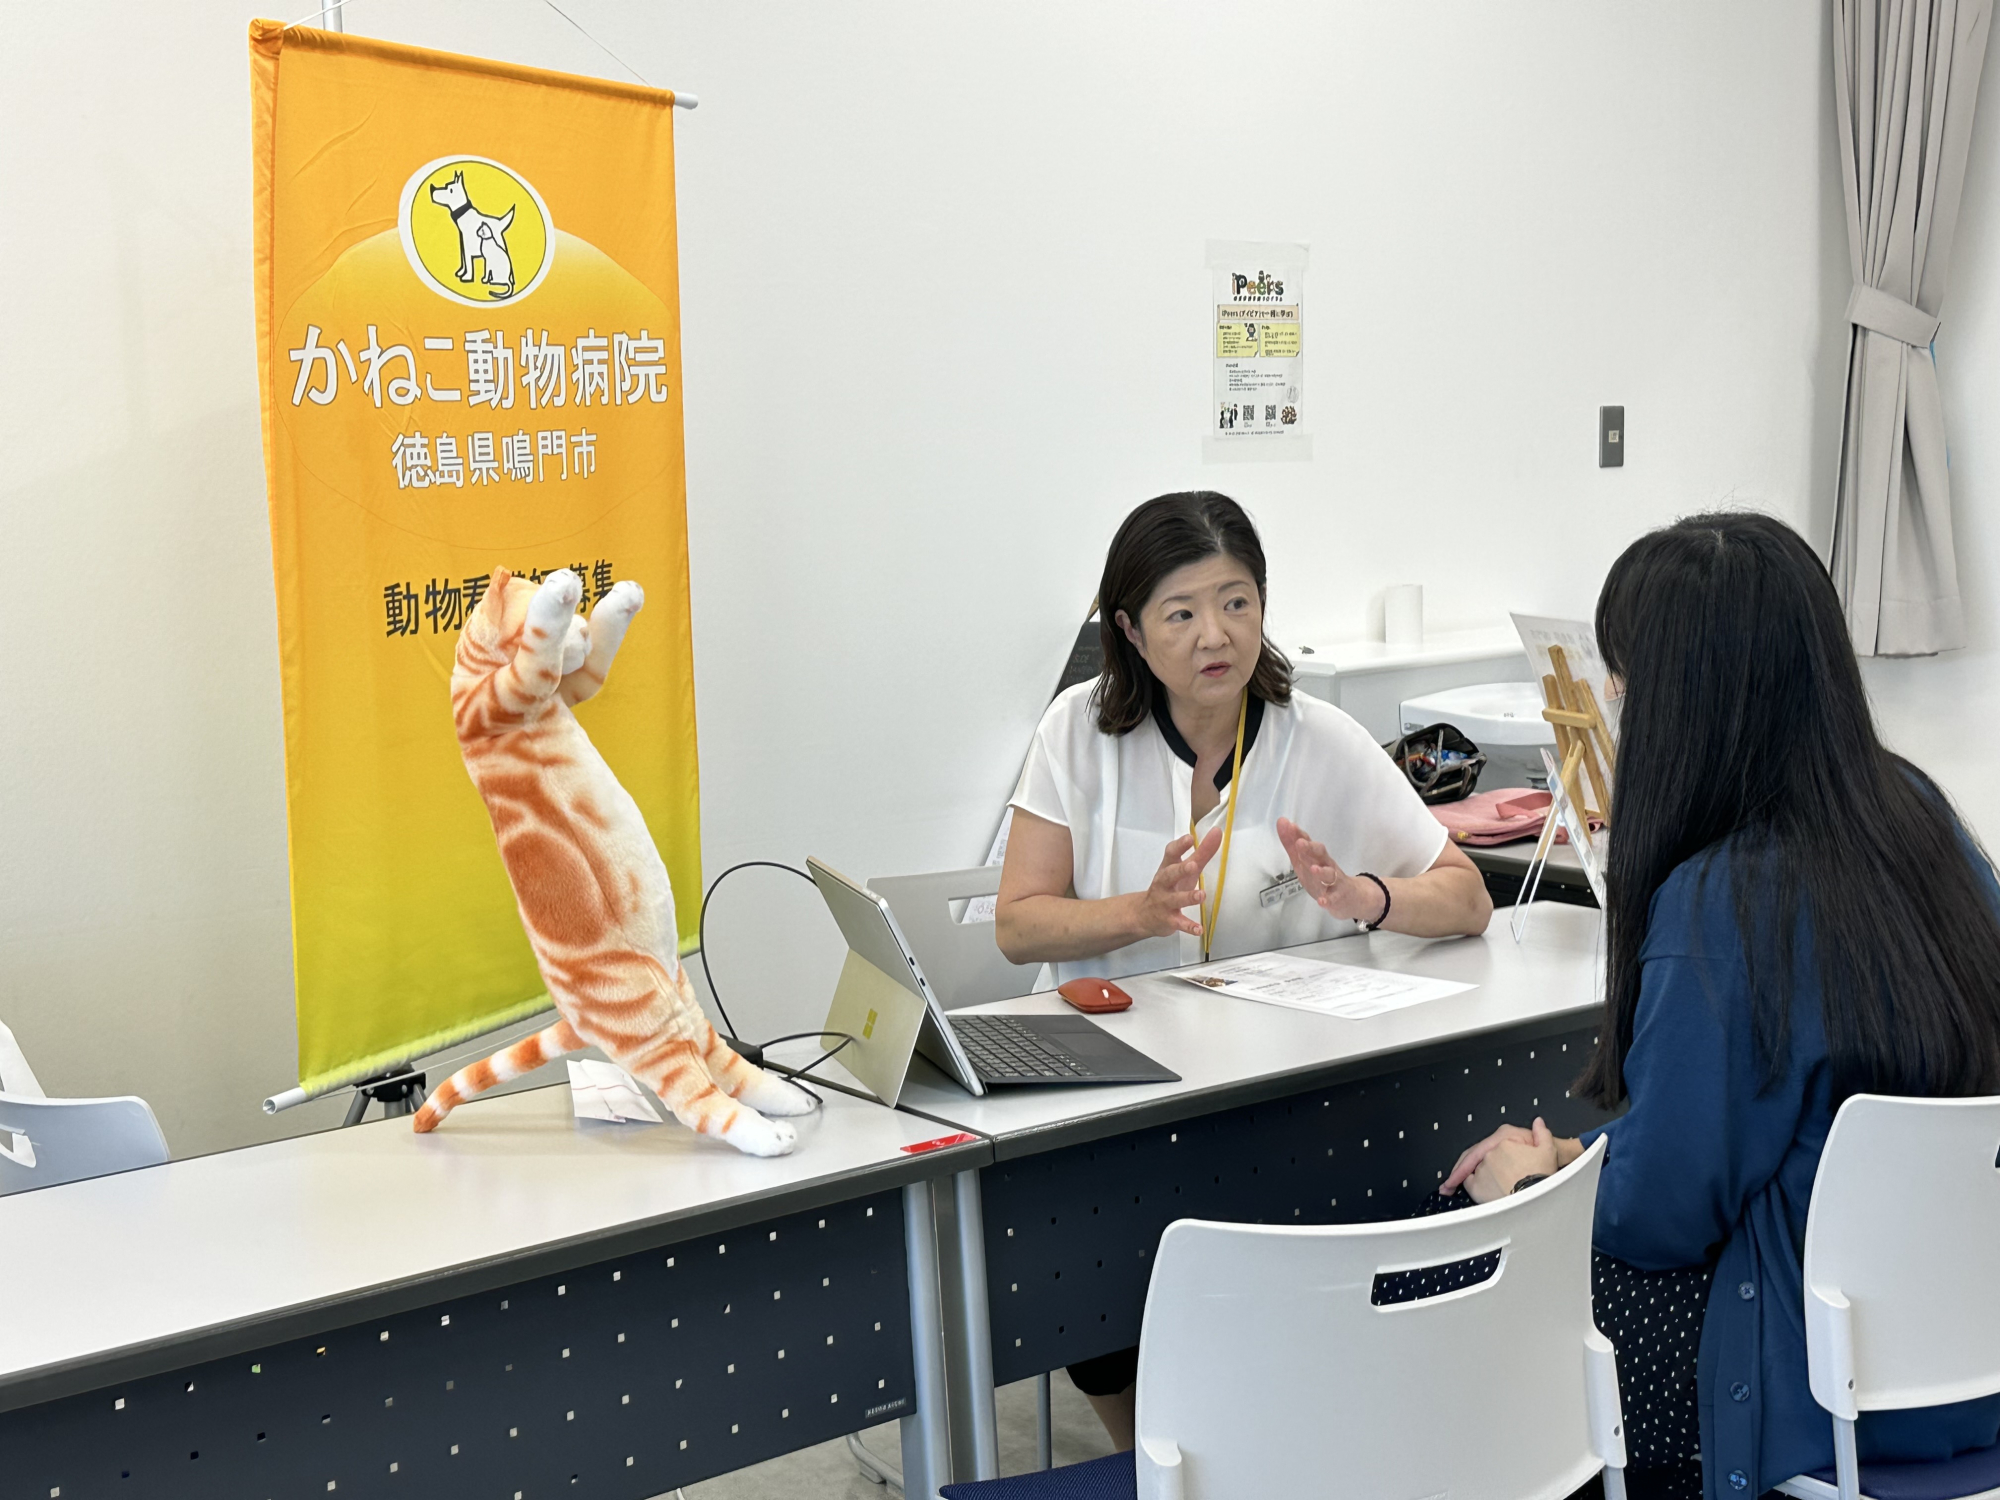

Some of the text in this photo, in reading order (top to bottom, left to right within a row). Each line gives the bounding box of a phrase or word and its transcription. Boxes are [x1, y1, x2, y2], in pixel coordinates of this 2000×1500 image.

[288, 324, 669, 409] かねこ動物病院
[391, 427, 598, 489] 徳島県鳴門市
[383, 559, 615, 638] 動物看集
